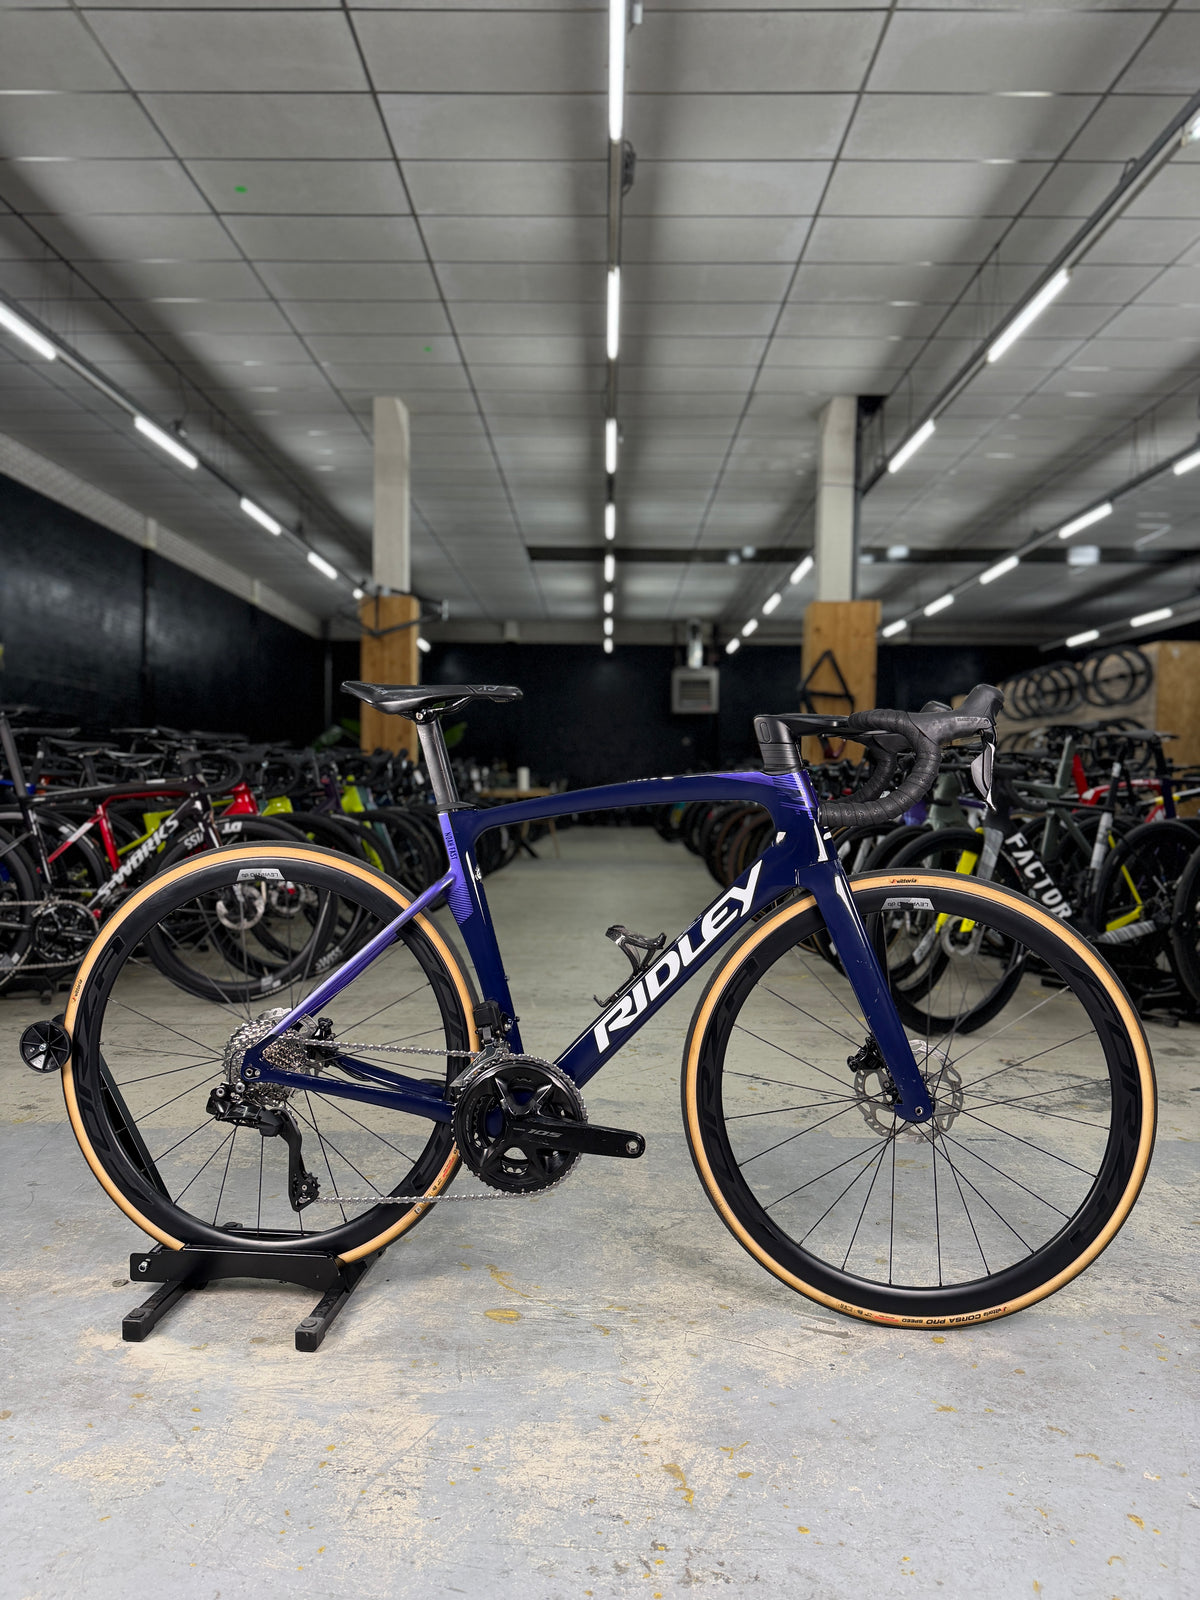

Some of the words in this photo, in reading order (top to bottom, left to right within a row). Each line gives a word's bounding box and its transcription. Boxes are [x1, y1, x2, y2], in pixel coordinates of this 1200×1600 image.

[448, 847, 458, 860] FAST
[1004, 832, 1073, 918] FACTOR
[593, 859, 763, 1054] RIDLEY
[528, 1128, 563, 1138] 105
[949, 1313, 982, 1324] CORSA
